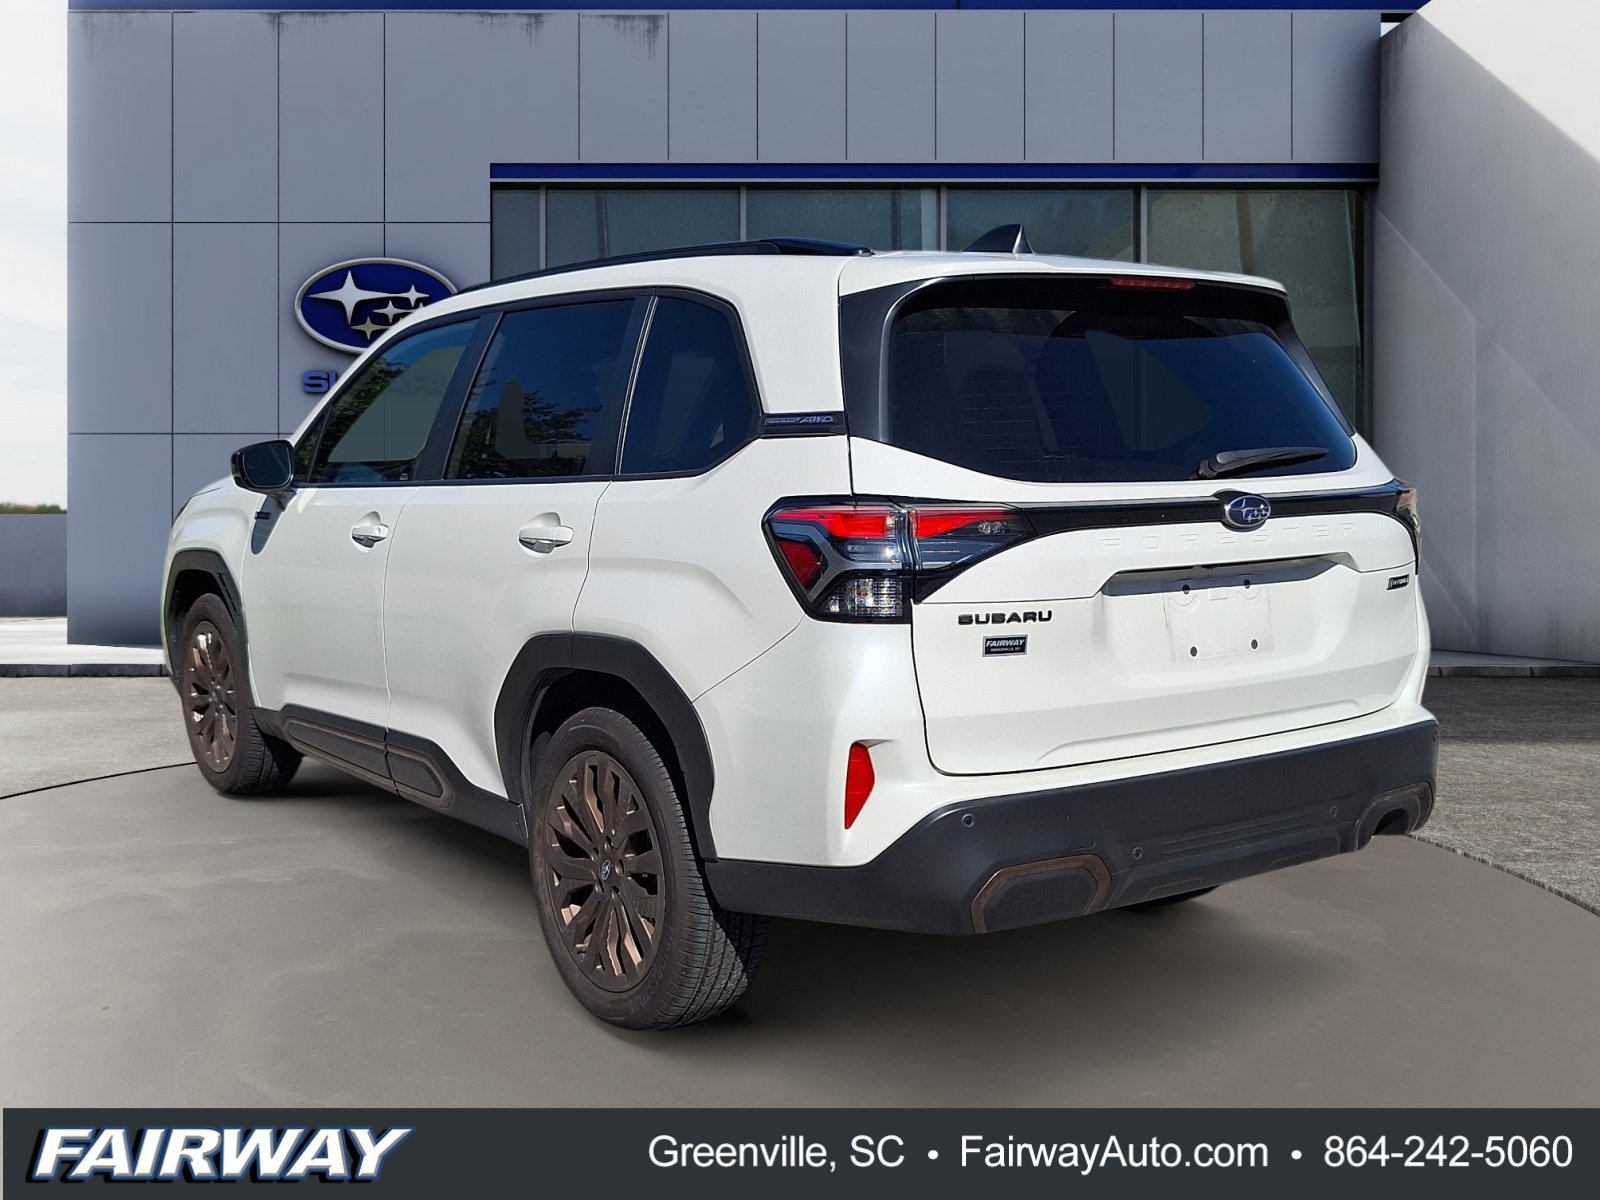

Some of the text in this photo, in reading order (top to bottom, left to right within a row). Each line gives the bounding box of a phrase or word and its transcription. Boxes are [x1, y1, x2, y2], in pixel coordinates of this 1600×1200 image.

[800, 415, 834, 424] AWD
[1099, 522, 1356, 551] FORESTER
[958, 610, 1052, 625] SUBARU
[986, 638, 1026, 648] FAIRWAY
